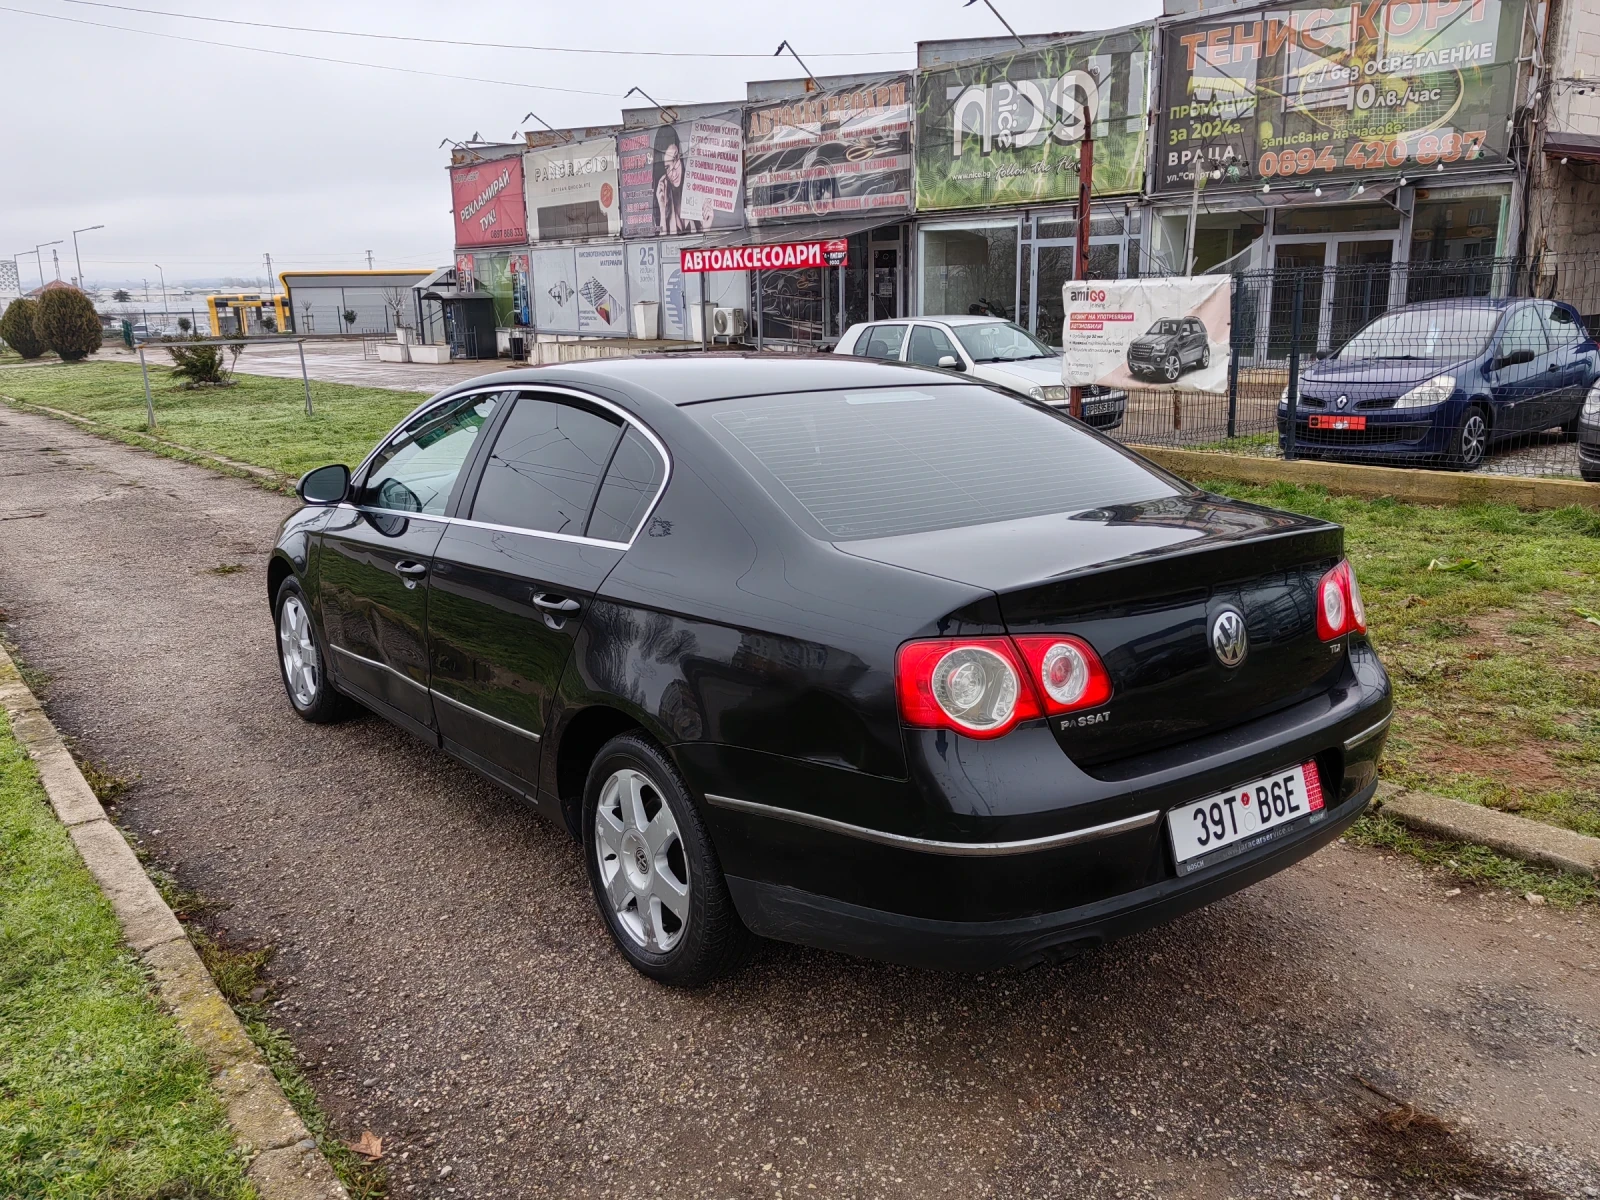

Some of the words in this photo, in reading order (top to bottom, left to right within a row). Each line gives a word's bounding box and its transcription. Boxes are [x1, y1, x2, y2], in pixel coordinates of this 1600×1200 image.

[1179, 7, 1334, 71] ТЕНИС
[1331, 62, 1360, 81] без
[1364, 41, 1494, 76] ОСВЕТЛЕНИЕ
[749, 83, 906, 137] АВТОАКСЕСОАРИ
[1169, 95, 1258, 120] ПРОМОЦИЯ
[1169, 127, 1188, 146] за
[1191, 120, 1245, 140] 2024г.
[1262, 133, 1329, 150] записване
[1332, 128, 1351, 141] на
[1352, 120, 1407, 138] часове:
[1259, 145, 1337, 177] 0894
[1344, 138, 1408, 170] 420
[1415, 130, 1487, 164] 887
[534, 156, 608, 183] PANCRACIO
[951, 170, 991, 182] www.nice.bg
[994, 162, 1028, 181] Follow
[1030, 159, 1052, 174] the
[460, 167, 511, 223] РЕКЛАМИРАЙ
[480, 208, 497, 232] ТУК!
[639, 246, 656, 266] 25
[684, 243, 821, 271] АВТОАКСЕСОАРИ
[1060, 711, 1111, 731] PASSAT
[1193, 795, 1238, 846] 39T
[1255, 775, 1300, 825] B6E
